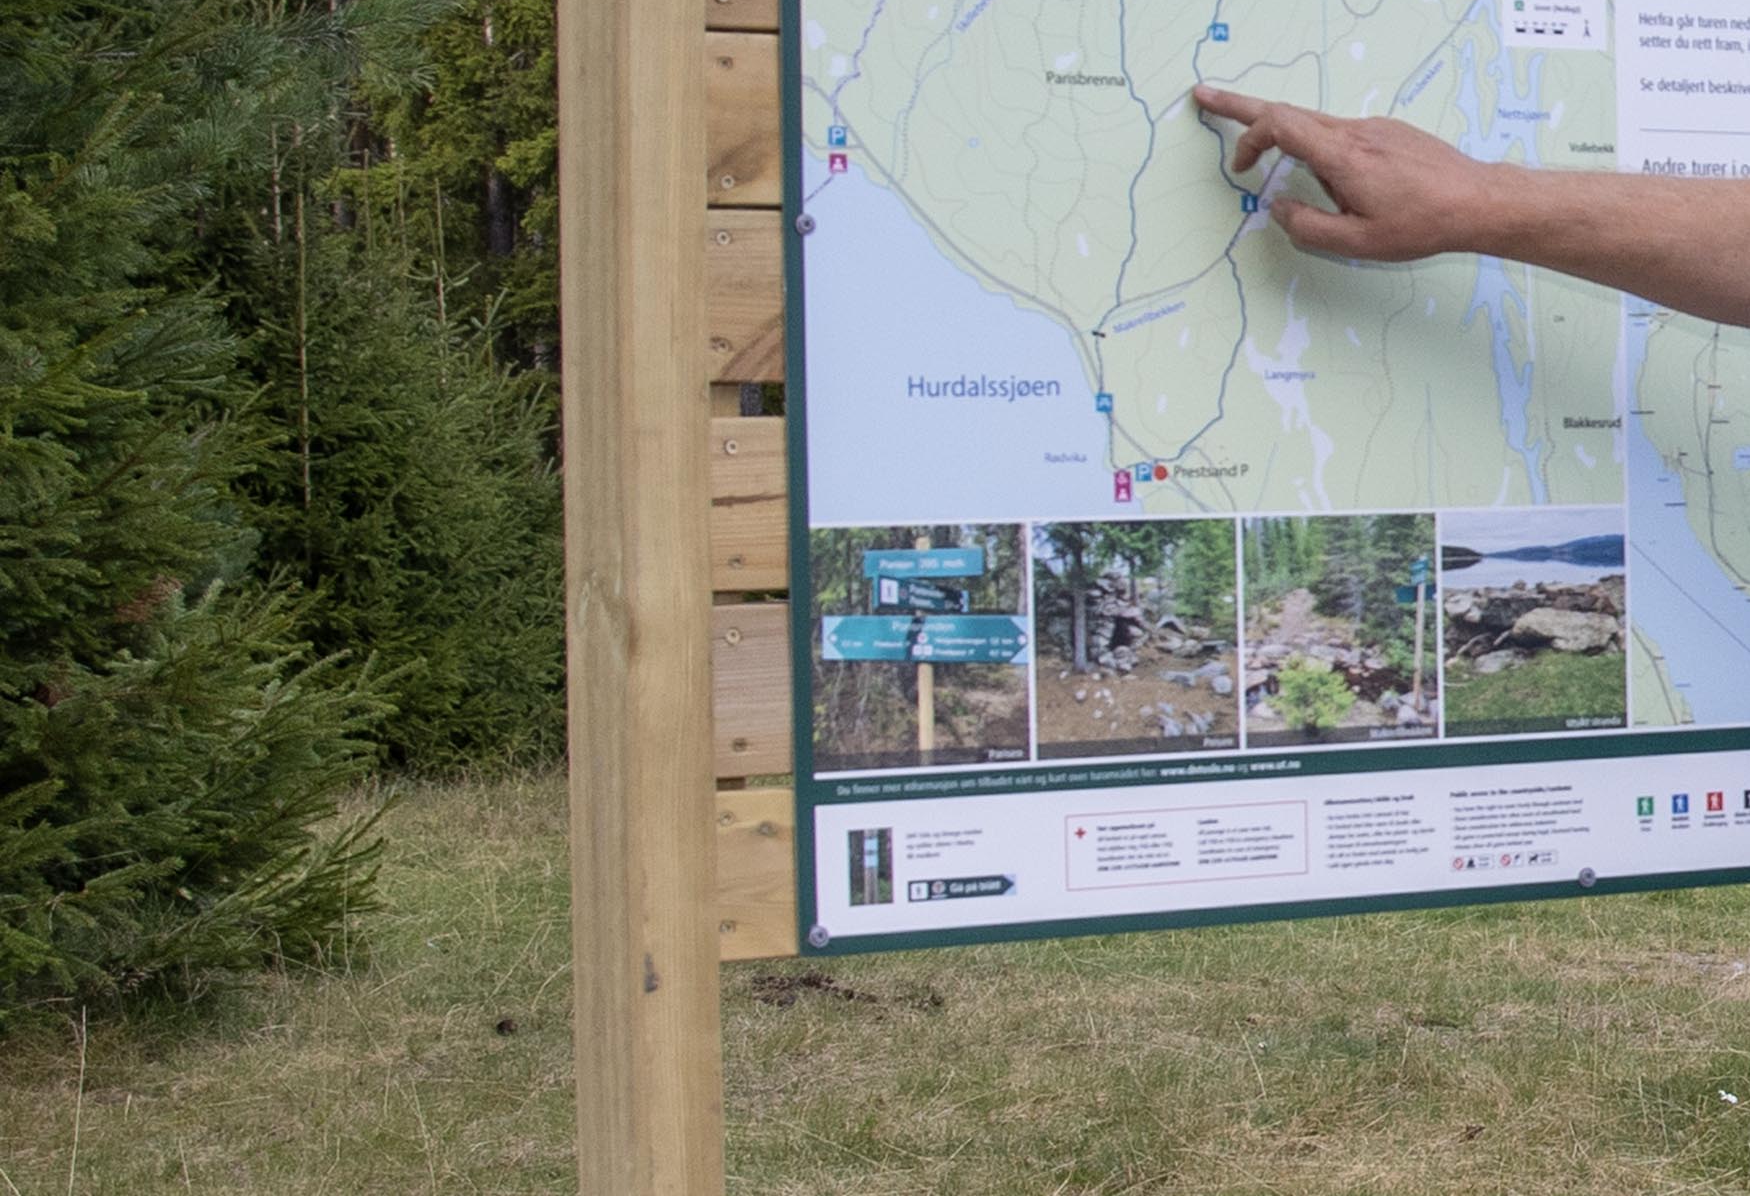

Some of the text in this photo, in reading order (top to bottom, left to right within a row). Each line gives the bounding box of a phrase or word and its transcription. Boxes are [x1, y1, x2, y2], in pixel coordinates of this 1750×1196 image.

[1638, 14, 1673, 27] Herfra
[1676, 15, 1694, 30] går
[1697, 18, 1727, 30] turen
[1046, 71, 1125, 87] Parisbrenna
[1640, 79, 1653, 91] Se
[1657, 80, 1705, 95] detaljert
[1642, 158, 1685, 175] Andre
[1693, 161, 1725, 177] turer
[907, 374, 1061, 403] Hurdalssjøen
[1173, 464, 1249, 480] Prestsand P
